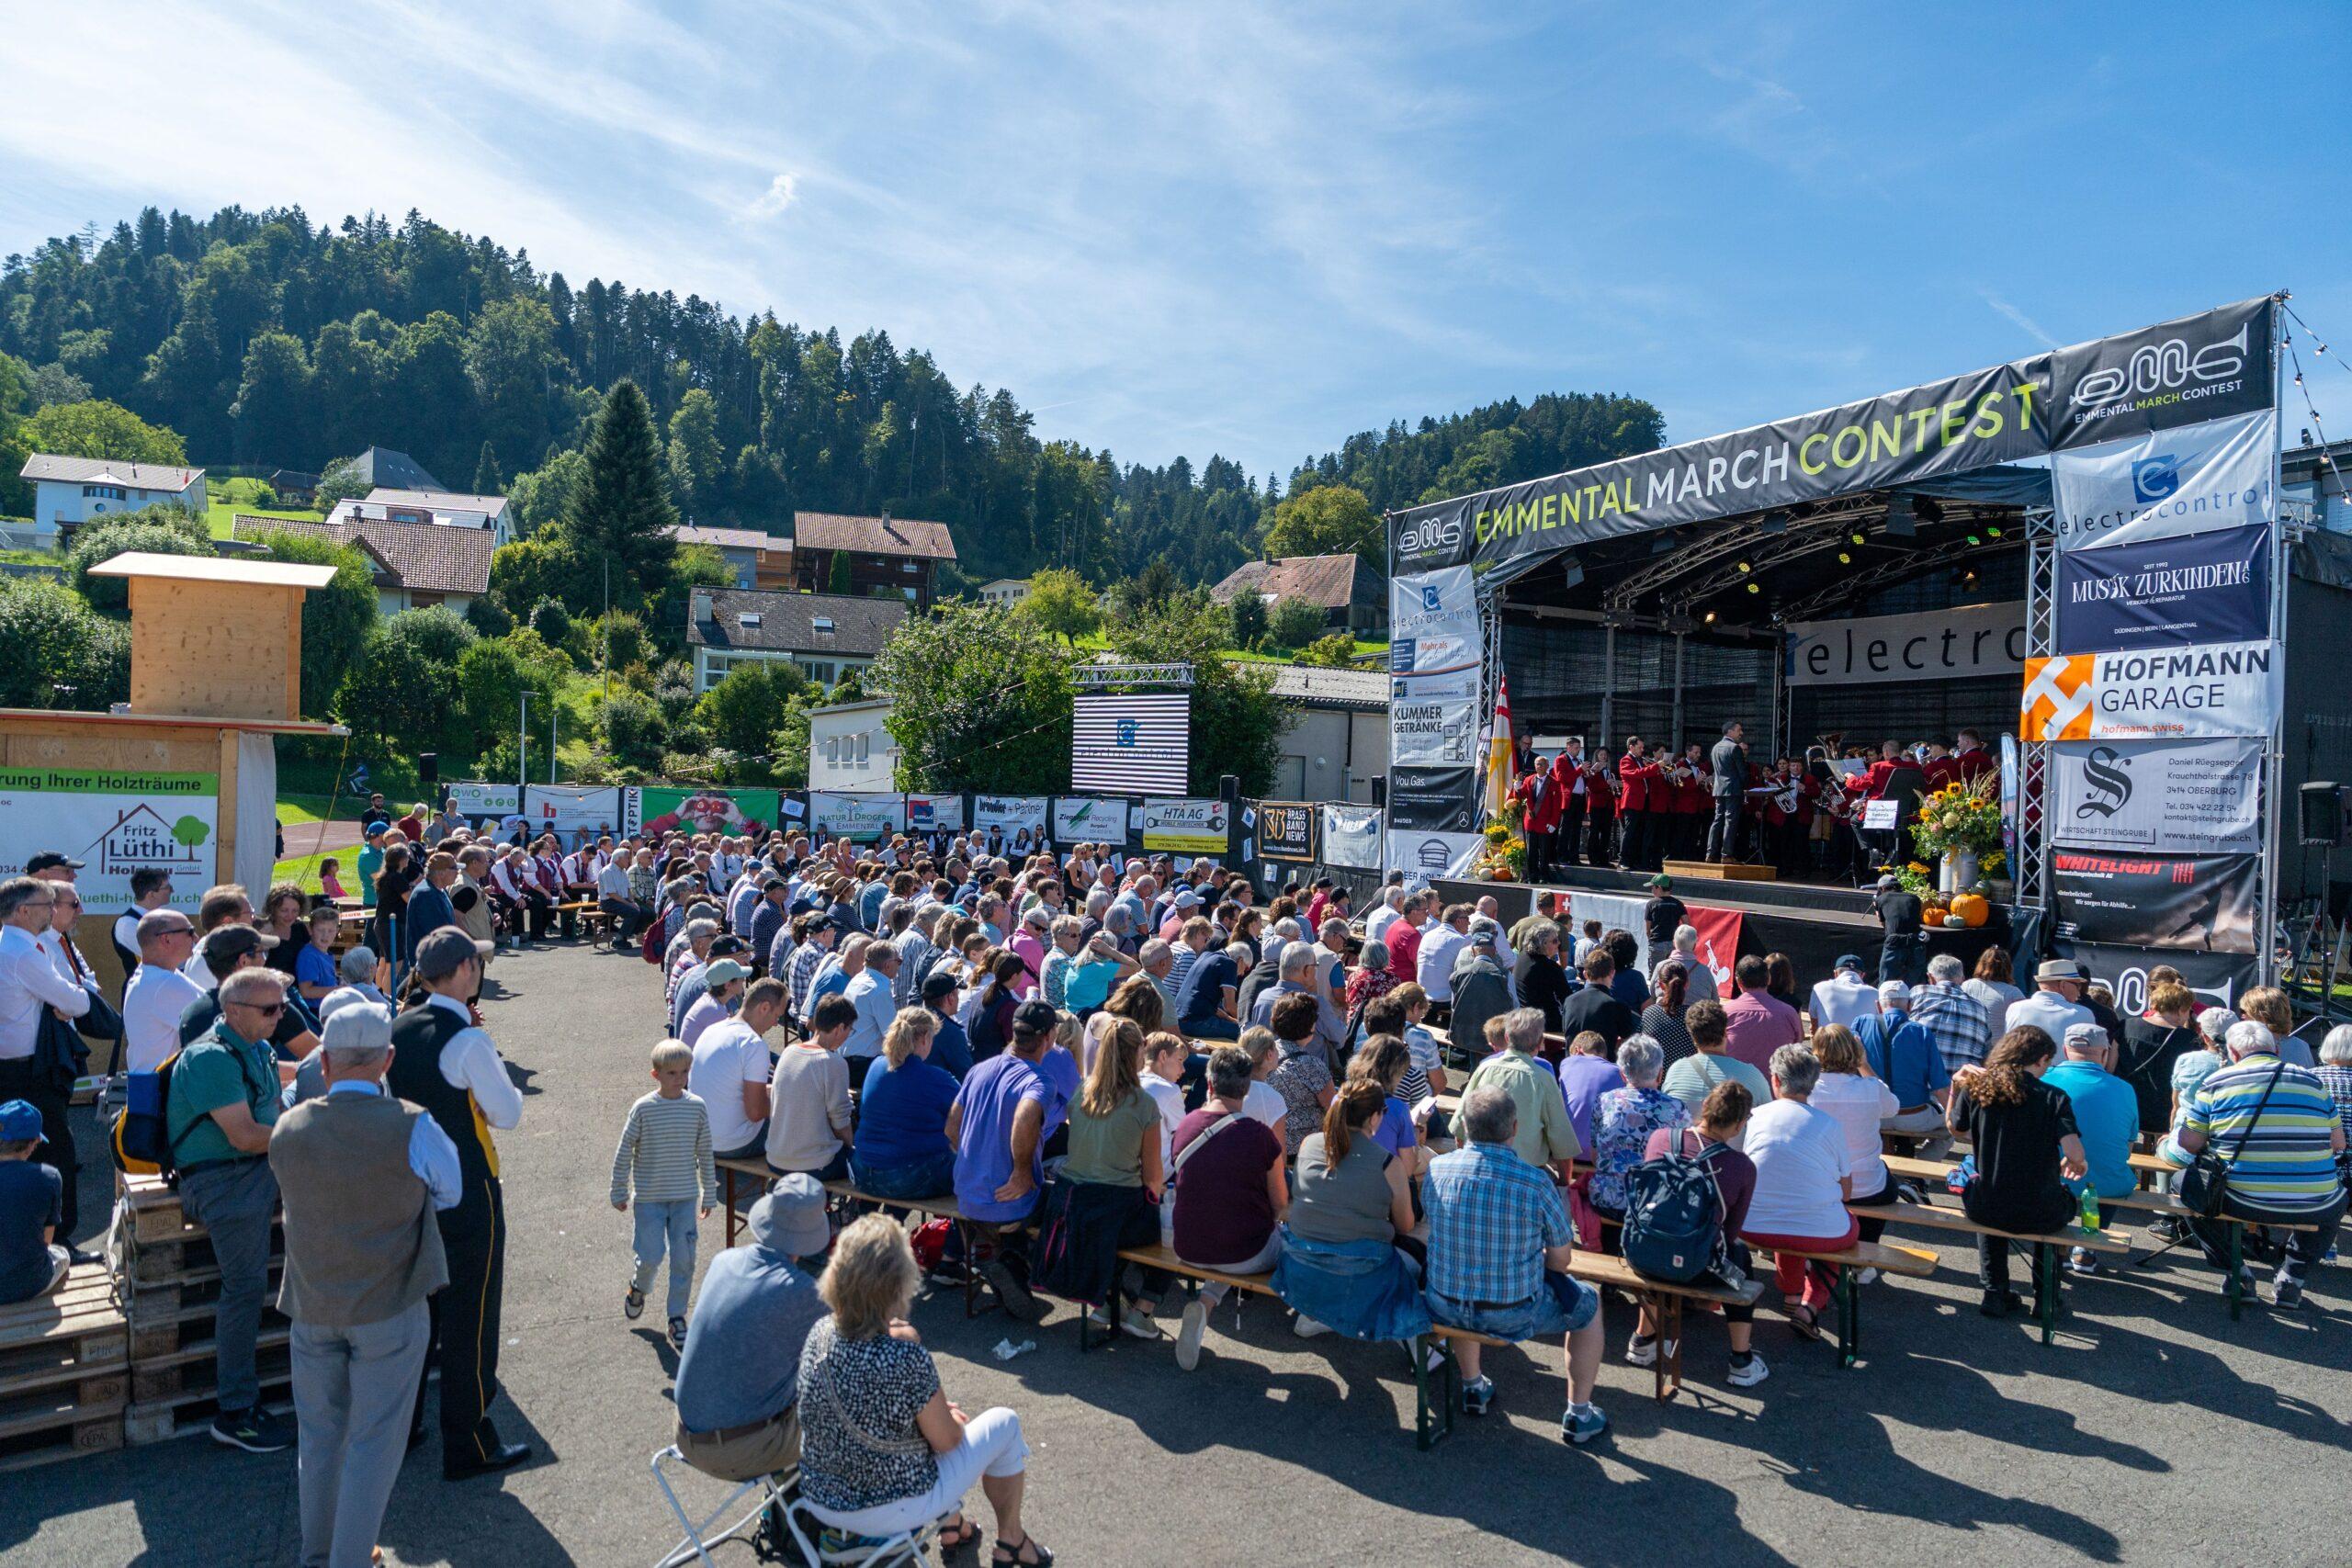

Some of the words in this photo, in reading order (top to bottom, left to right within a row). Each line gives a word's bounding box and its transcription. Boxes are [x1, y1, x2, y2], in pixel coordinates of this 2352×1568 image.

[2075, 401, 2135, 423] EMMENTAL
[2136, 392, 2180, 410] MARCH
[2182, 379, 2243, 400] CONTEST
[1476, 477, 1640, 544] EMMENTAL
[1646, 441, 1790, 509] MARCH
[1800, 382, 2040, 476] CONTEST
[2060, 480, 2270, 536] electrocontrol
[1400, 552, 1421, 562] EMMENTAL
[1421, 549, 1437, 558] MARCH
[1438, 545, 1459, 555] CONTEST
[2135, 561, 2242, 596] ZURKINDEN
[2161, 622, 2198, 630] LANGENTHAL
[1420, 641, 1438, 650] Mehr
[1438, 640, 1448, 649] als
[2102, 649, 2270, 682] HOFMANN
[2101, 683, 2225, 712] GARAGE
[1394, 706, 1442, 720] KUMMER
[1394, 720, 1442, 733] GETRÄNKE
[2101, 723, 2185, 733] hofmann.swiss
[49, 774, 91, 788] Ihrer
[98, 775, 201, 791] Holzträume
[1410, 775, 1426, 786] Gas.
[2167, 773, 2240, 781] Krauchthalstrasse
[2188, 786, 2236, 795] OBERBURG
[1015, 803, 1044, 815] Partner
[1163, 807, 1186, 819] HTA
[1187, 808, 1204, 819] AG
[1287, 809, 1306, 819] BRASS
[854, 813, 894, 822] DROGERIE
[1091, 815, 1118, 823] Recycling
[2164, 814, 2250, 824] kontakt@steingrube.ch
[124, 825, 157, 837] Fritz
[1286, 820, 1306, 830] BAND
[1286, 831, 1306, 842] NEWS
[2061, 826, 2101, 834] WIRTSCHAFT
[2103, 828, 2148, 837] STEINGRUBE
[2165, 832, 2251, 843] www.steingrube.ch
[109, 840, 174, 857] Lüthi
[2055, 855, 2168, 874] WHITELIGHT
